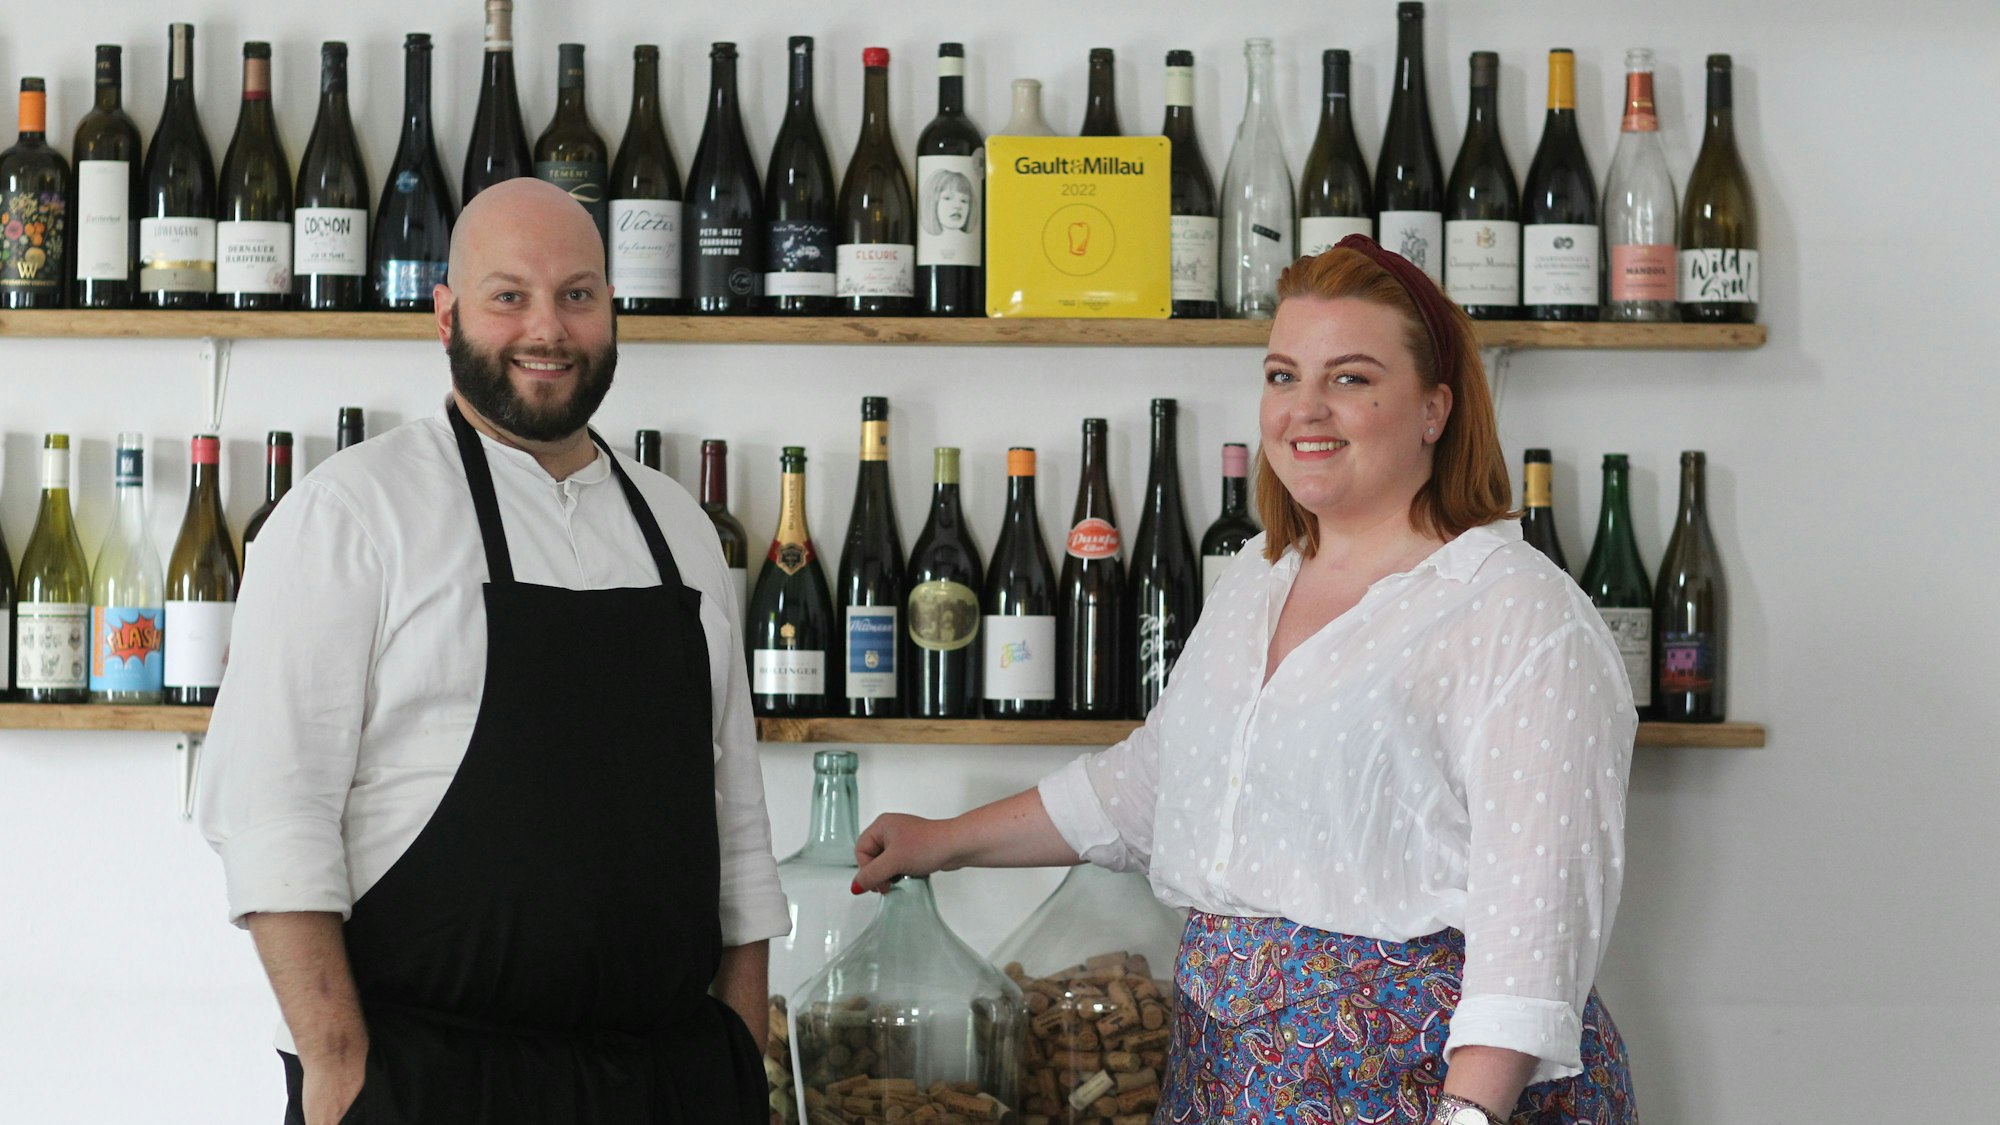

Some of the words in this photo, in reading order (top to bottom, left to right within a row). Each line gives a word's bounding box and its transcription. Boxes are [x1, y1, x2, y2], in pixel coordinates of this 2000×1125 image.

[1061, 183, 1097, 196] 2022
[304, 216, 351, 234] COCHON
[855, 249, 899, 261] FLEURIE
[107, 626, 163, 656] FLASH
[759, 667, 818, 676] BOLLINGER
